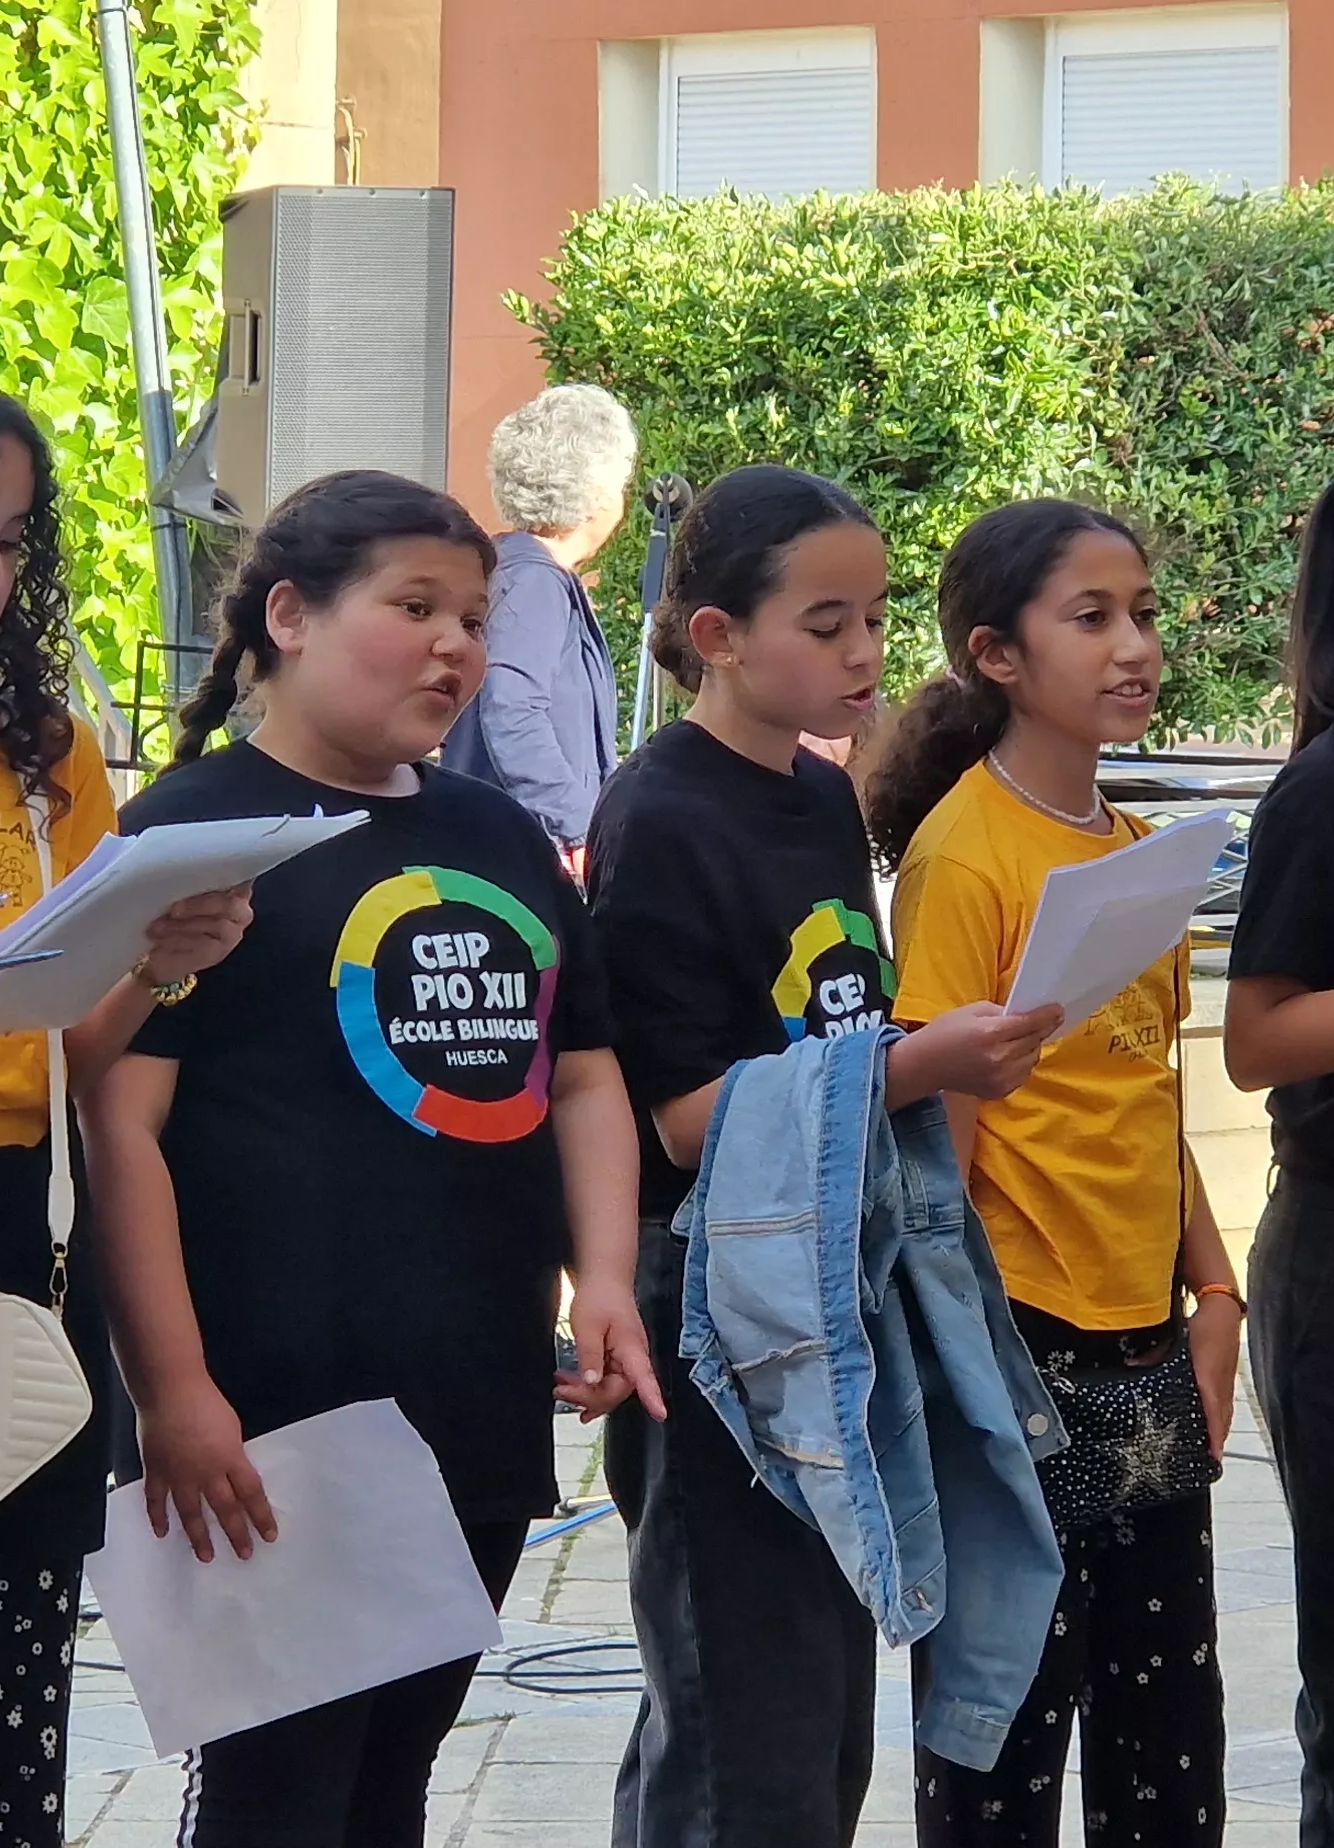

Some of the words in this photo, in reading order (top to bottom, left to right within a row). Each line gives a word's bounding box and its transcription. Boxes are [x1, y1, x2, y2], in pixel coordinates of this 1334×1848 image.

[412, 932, 489, 970] CEIP
[411, 973, 473, 1011] PIO
[479, 971, 526, 1010] XII
[389, 1017, 454, 1044] ÉCOLE
[457, 1018, 539, 1041] BILINGUE
[445, 1049, 508, 1066] HUESCA
